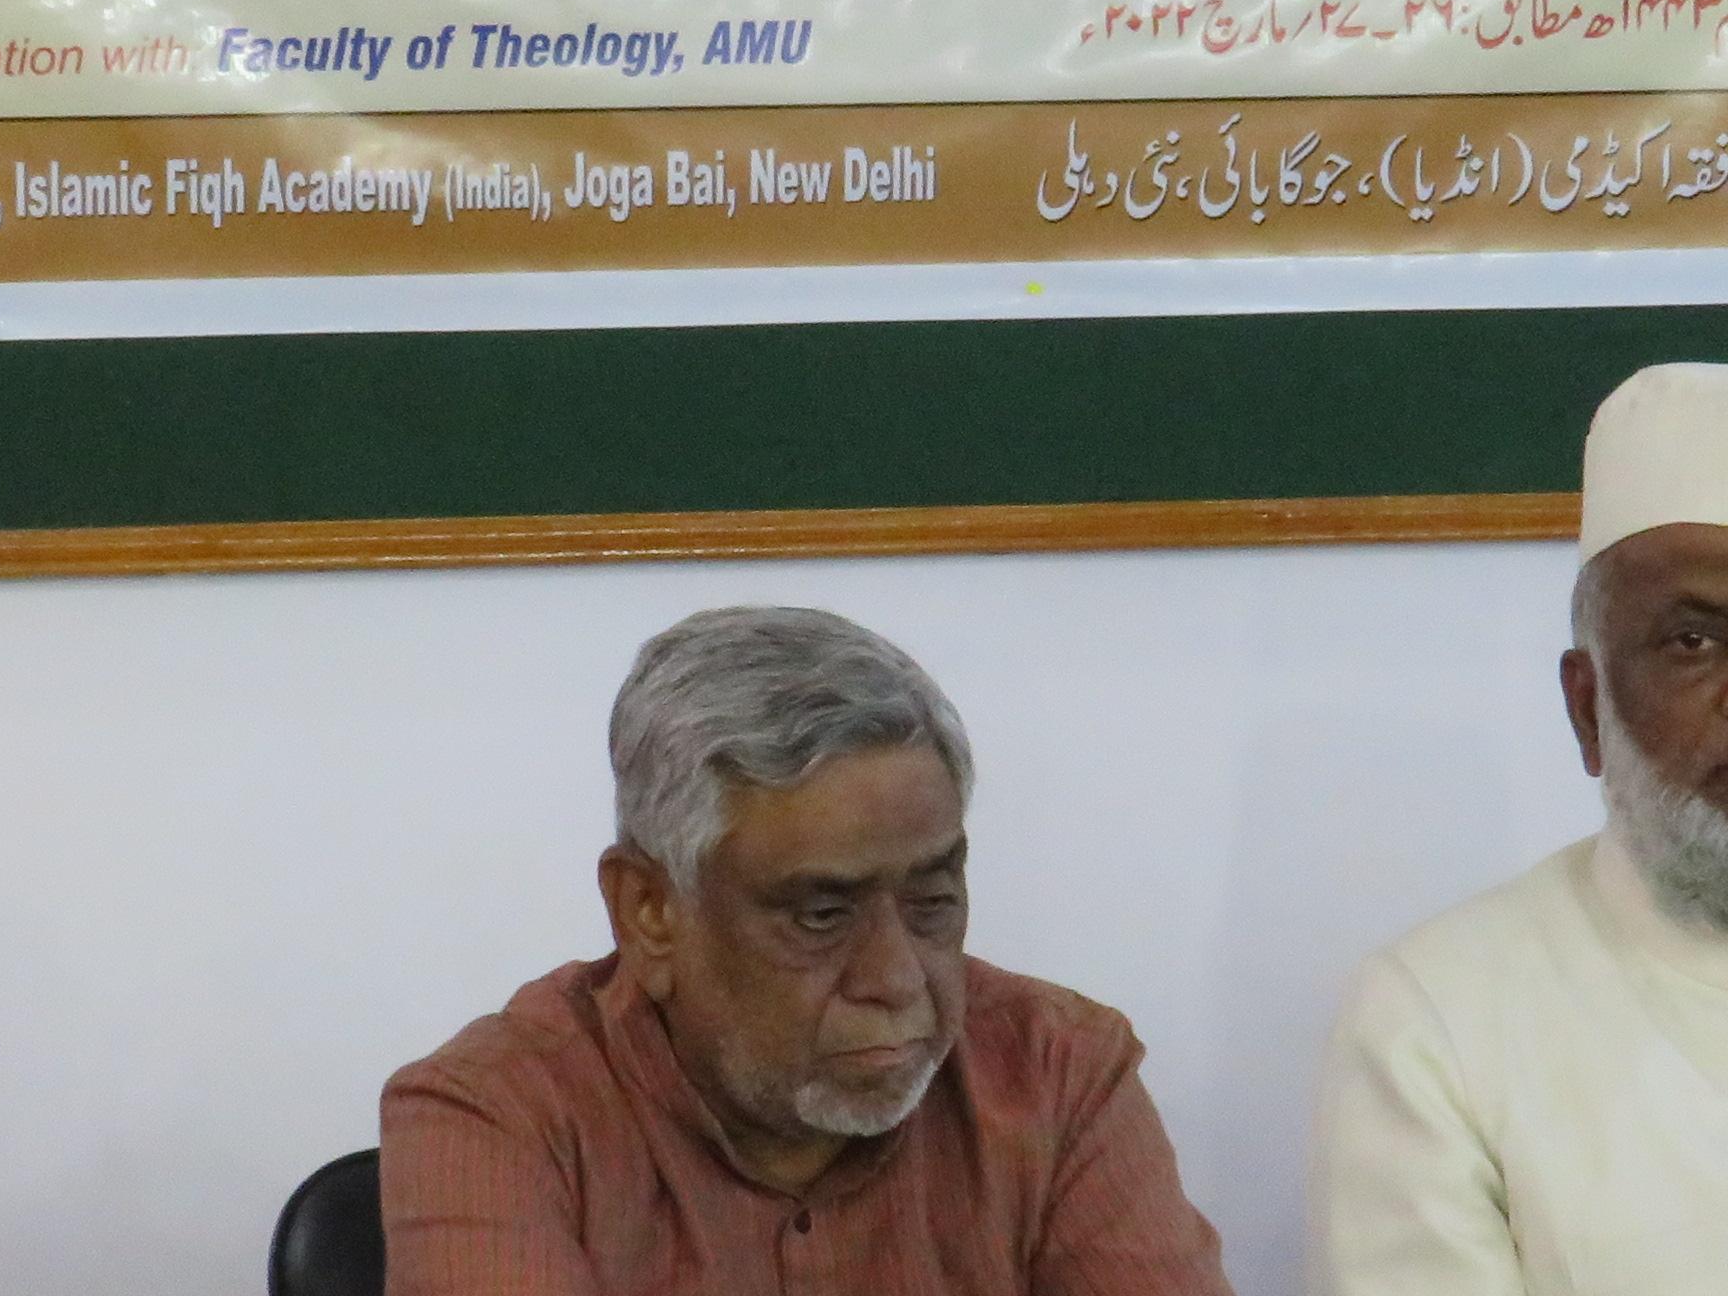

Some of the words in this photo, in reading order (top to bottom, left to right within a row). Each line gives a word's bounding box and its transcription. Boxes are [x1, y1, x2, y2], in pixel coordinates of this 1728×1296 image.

[218, 26, 392, 81] Faculty
[406, 23, 455, 69] of
[471, 22, 686, 77] Theology,
[702, 19, 813, 66] AMU
[15, 160, 153, 219] Islamic
[165, 158, 245, 228] Fiqh
[257, 155, 432, 226] Academy
[444, 162, 553, 222] (India),
[564, 151, 654, 222] Joga
[666, 149, 737, 218] Bai,
[749, 148, 833, 205] New
[843, 146, 937, 203] Delhi
[1036, 117, 1120, 223] دہلی
